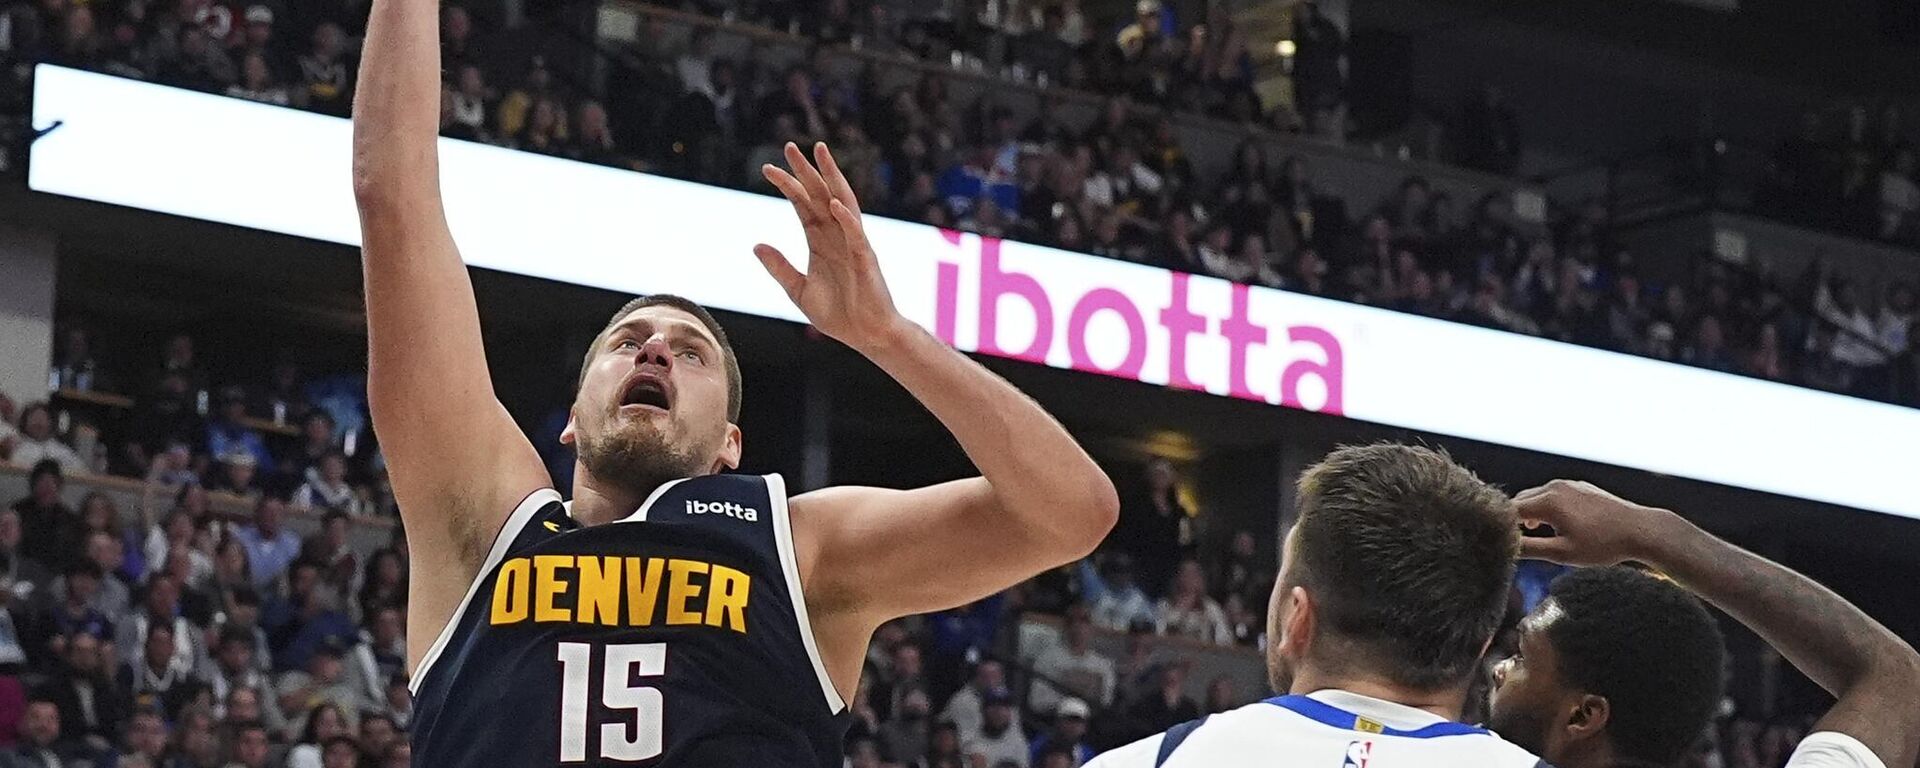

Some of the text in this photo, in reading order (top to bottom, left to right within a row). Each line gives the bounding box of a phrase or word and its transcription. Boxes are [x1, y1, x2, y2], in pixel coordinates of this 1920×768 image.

[935, 228, 1344, 415] ibotta
[685, 500, 758, 522] ibotta
[490, 555, 750, 634] DENVER
[557, 642, 667, 762] 15
